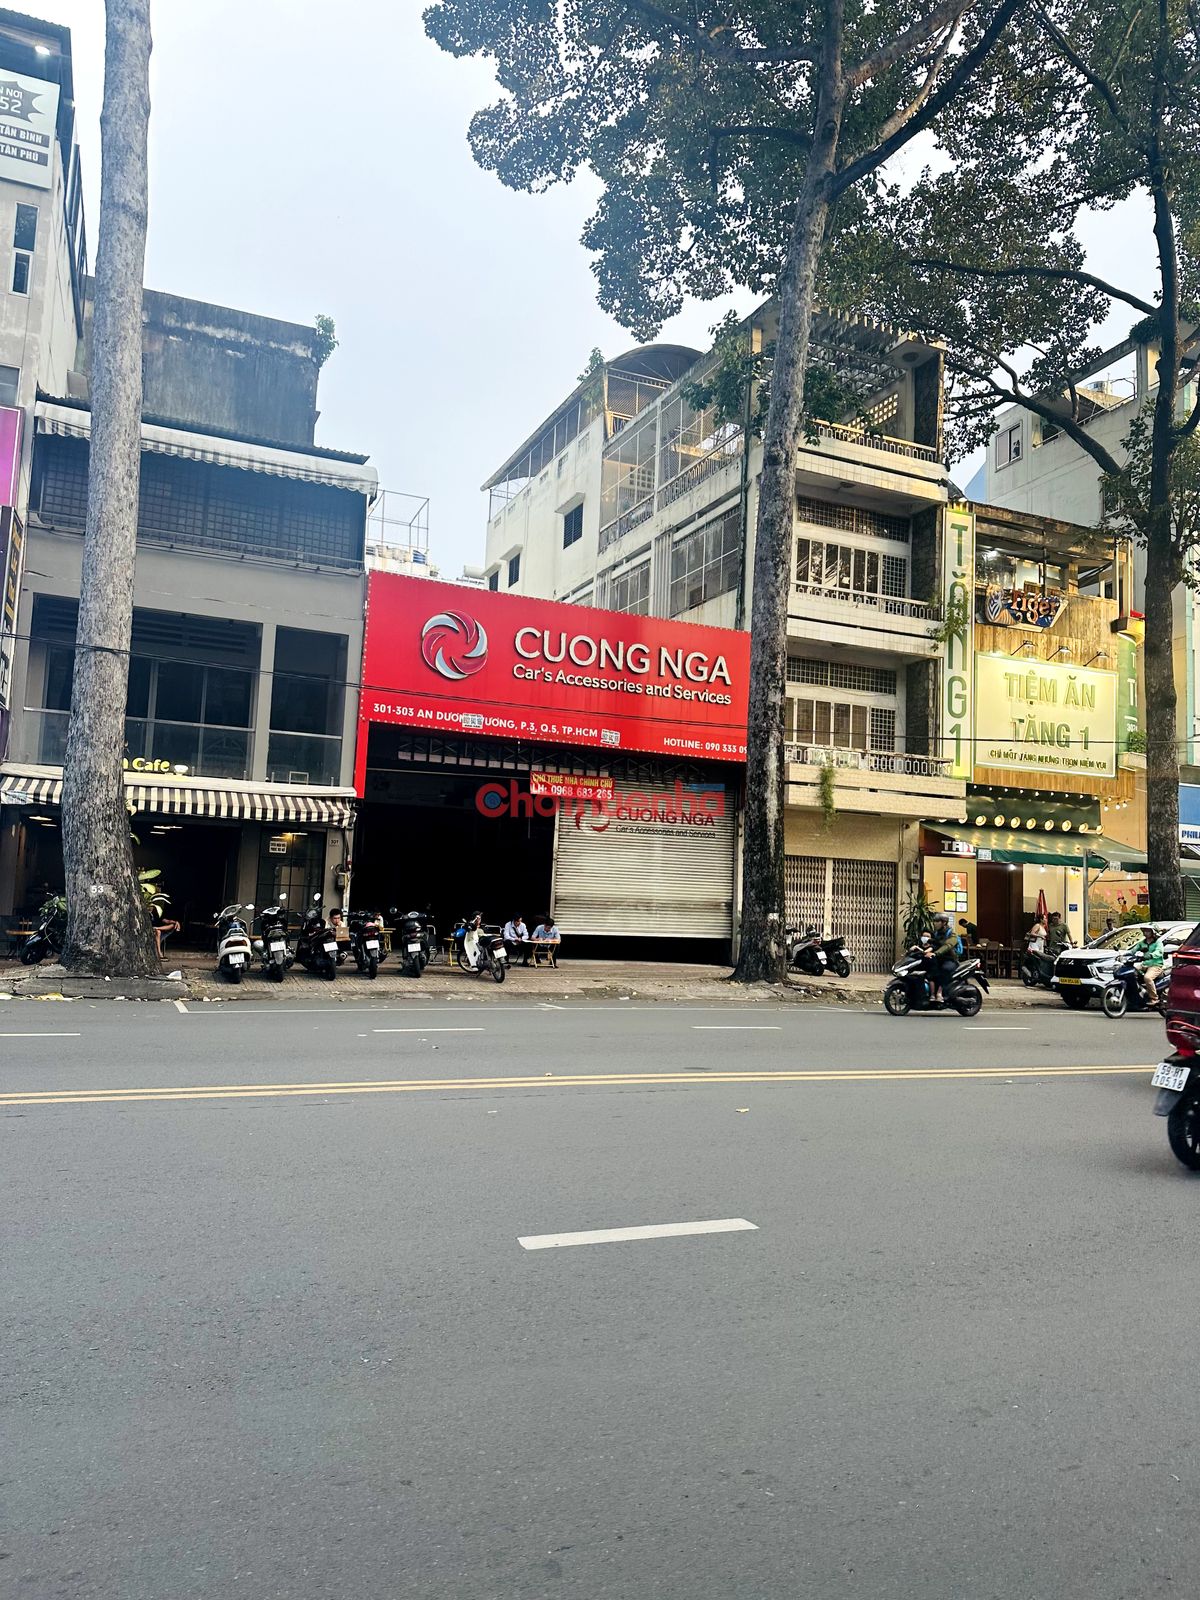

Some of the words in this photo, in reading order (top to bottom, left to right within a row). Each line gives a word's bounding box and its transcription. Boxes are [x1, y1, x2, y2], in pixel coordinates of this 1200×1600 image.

[1010, 590, 1058, 624] Tiger
[514, 626, 651, 675] CUONG
[659, 646, 732, 685] NGA
[513, 663, 552, 682] Car's
[555, 669, 643, 694] Accessories
[646, 683, 671, 698] and
[673, 685, 732, 705] Services
[1004, 669, 1058, 705] TIỆM
[1065, 674, 1096, 708] ĂN
[373, 703, 414, 717] 301-303
[417, 710, 433, 720] AN
[520, 721, 538, 732] P.3,
[562, 726, 598, 738] TP.HCM
[663, 737, 703, 750] HOTLINE:
[705, 742, 720, 752] 090
[722, 743, 737, 753] 333
[949, 723, 961, 767] 1
[1079, 726, 1089, 750] 1
[132, 757, 170, 772] Cafe
[547, 774, 564, 784] THUÊ
[551, 785, 573, 796] 0968
[576, 787, 593, 798] 683
[596, 788, 612, 799] 265
[616, 808, 677, 824] CUONG
[681, 812, 715, 826] NGA
[91, 885, 104, 894] 53
